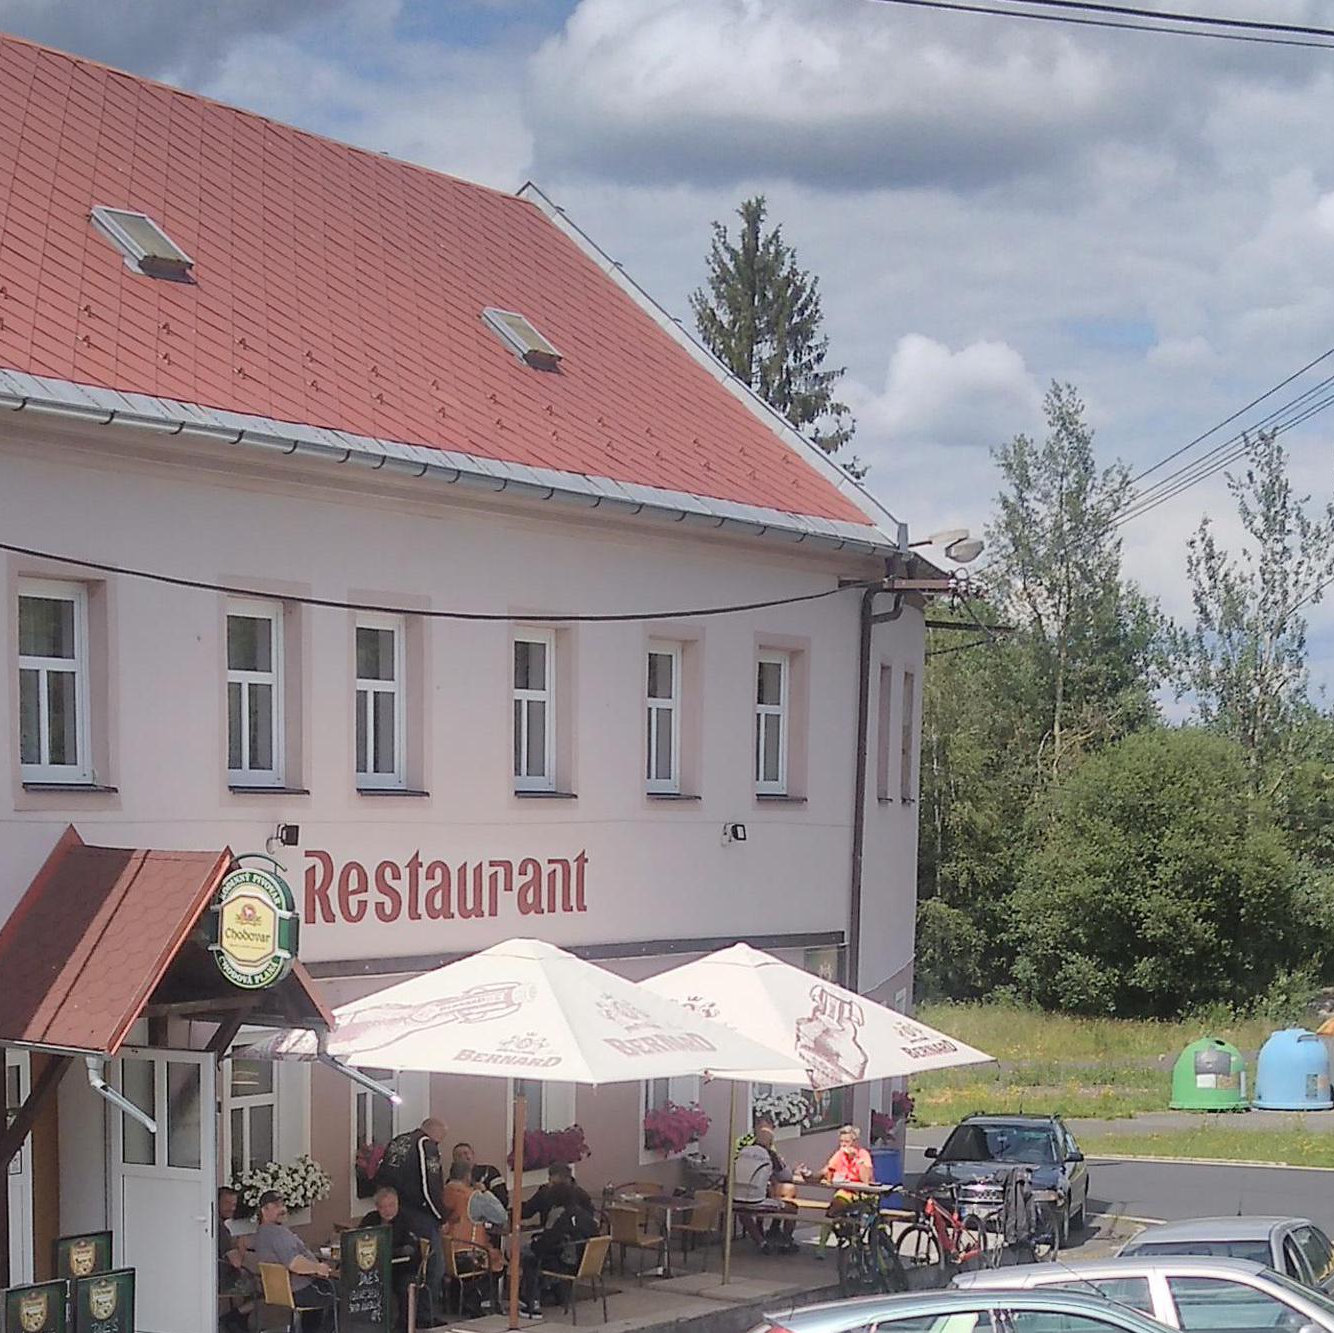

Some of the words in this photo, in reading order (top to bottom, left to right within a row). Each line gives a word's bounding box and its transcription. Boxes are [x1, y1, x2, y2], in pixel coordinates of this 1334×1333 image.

[304, 849, 589, 924] Restaurant
[224, 926, 271, 943] Chodovar
[453, 1049, 562, 1068] BERNARD
[900, 1039, 957, 1059] BERNARD
